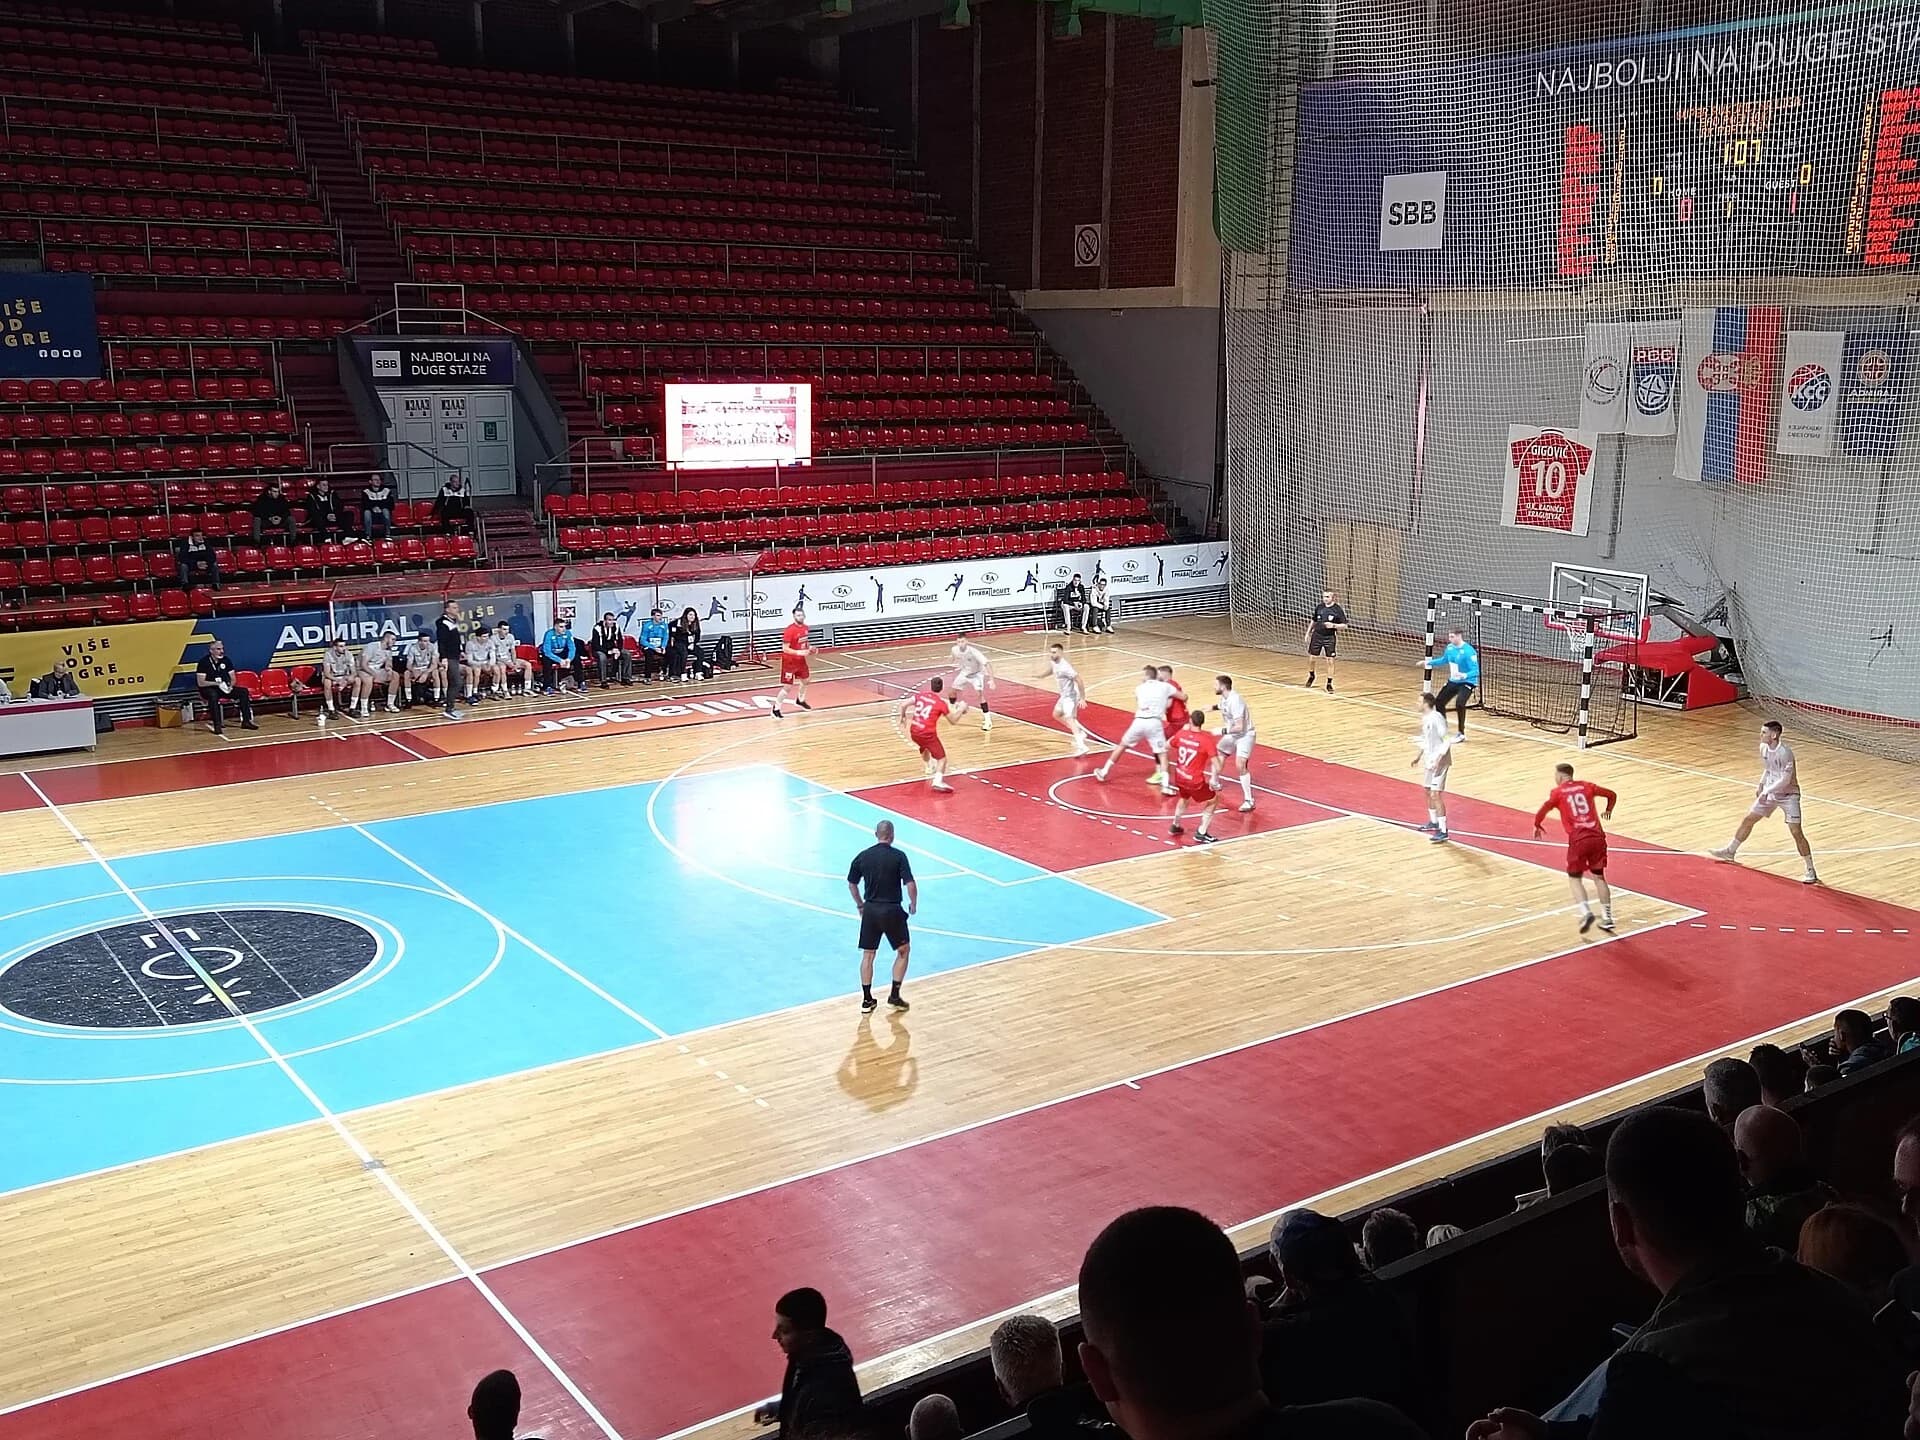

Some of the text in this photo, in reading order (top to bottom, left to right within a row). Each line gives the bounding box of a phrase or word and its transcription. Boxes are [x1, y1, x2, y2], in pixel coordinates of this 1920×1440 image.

[1536, 52, 1680, 98] NAJBOLJI
[1693, 46, 1739, 78] NA
[1753, 29, 1851, 70] DUGE
[1388, 200, 1438, 226] SBB
[2, 298, 42, 316] IŠE
[4, 330, 51, 347] GRE
[375, 359, 398, 369] SBB
[410, 351, 492, 363] NAJBOLJI NA
[411, 364, 488, 375] DUGE STAZE
[1530, 445, 1569, 460] GIGOVIĆ
[1531, 461, 1566, 498] 10
[276, 616, 420, 649] ADMIRAL
[61, 638, 110, 656] VIŠE
[66, 655, 93, 668] OD
[914, 701, 933, 720] 24
[1178, 746, 1198, 767] 97
[1567, 792, 1590, 817] 19
